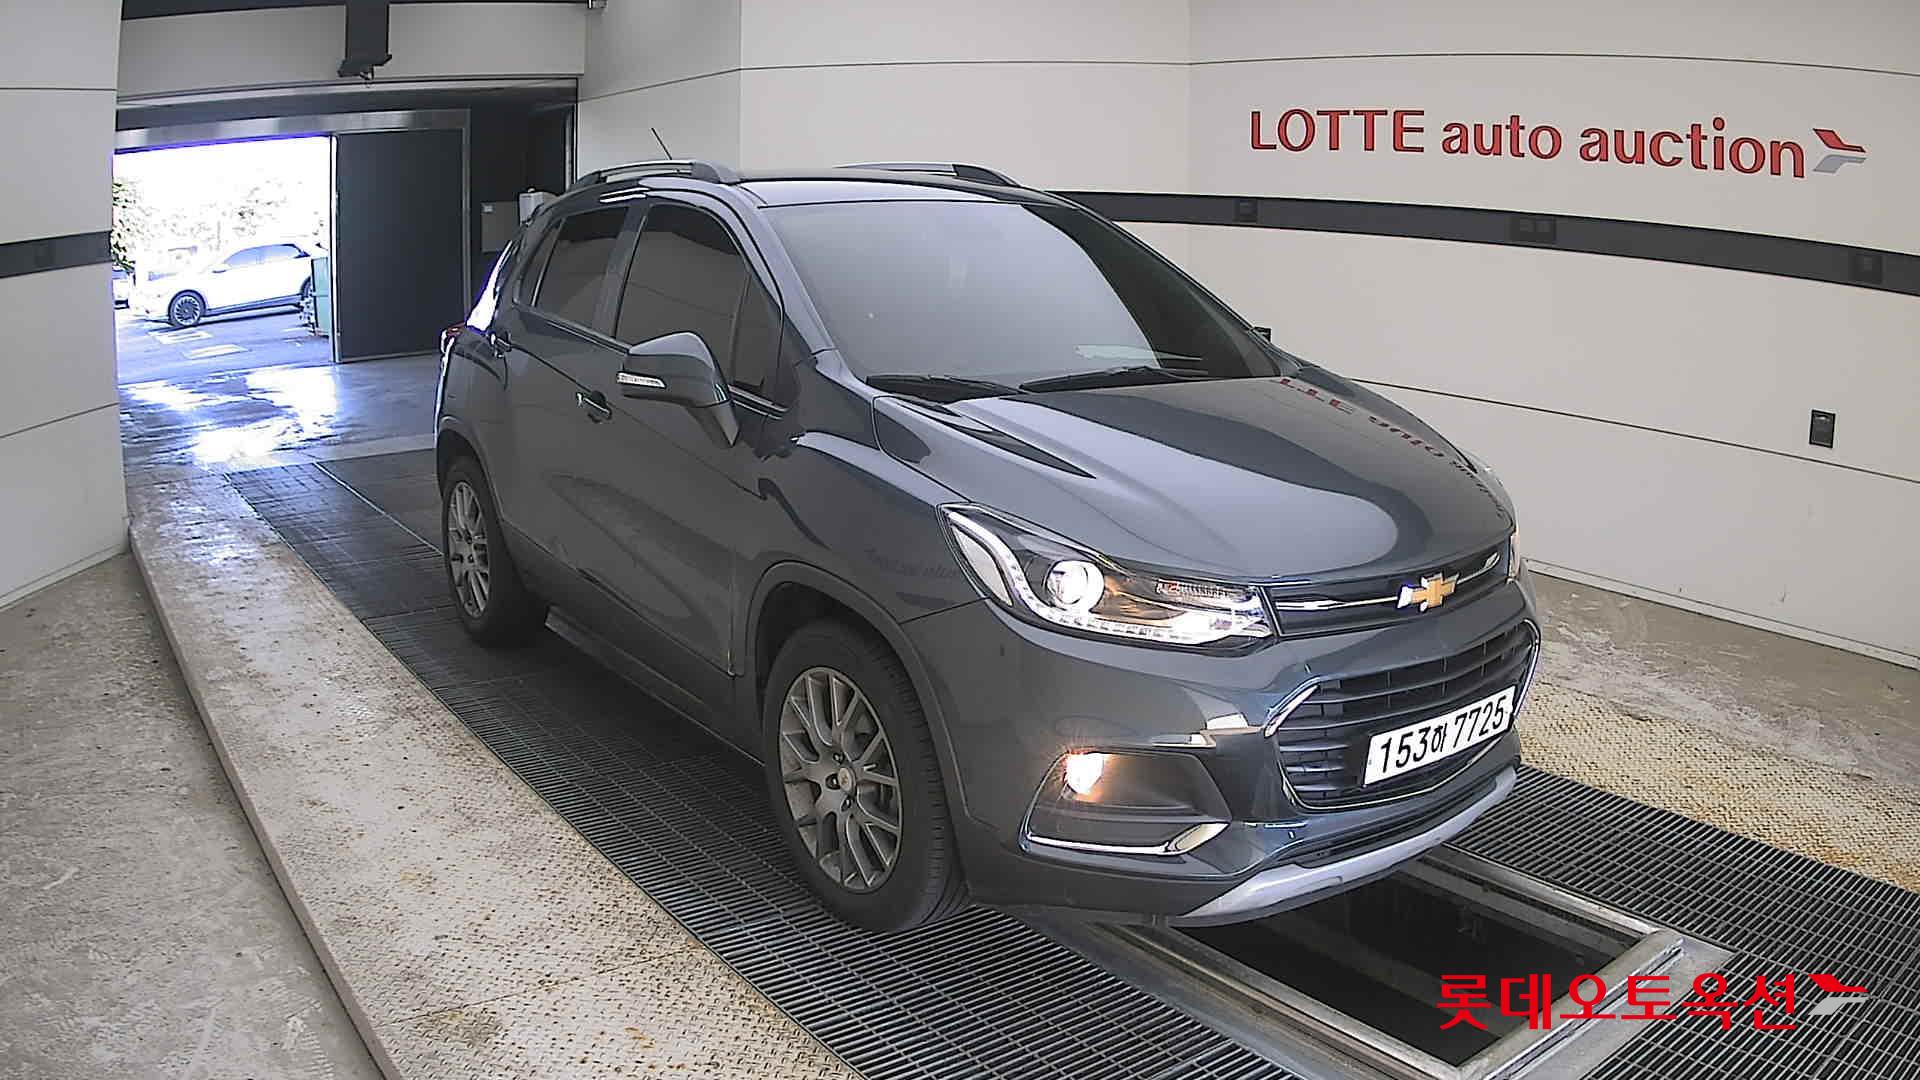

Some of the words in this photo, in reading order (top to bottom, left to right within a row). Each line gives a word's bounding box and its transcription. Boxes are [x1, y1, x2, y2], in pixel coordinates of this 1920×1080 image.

[1250, 109, 1425, 152] LOTTE
[1441, 115, 1562, 160] auto
[1578, 117, 1806, 178] auction
[1453, 695, 1507, 748] 7725
